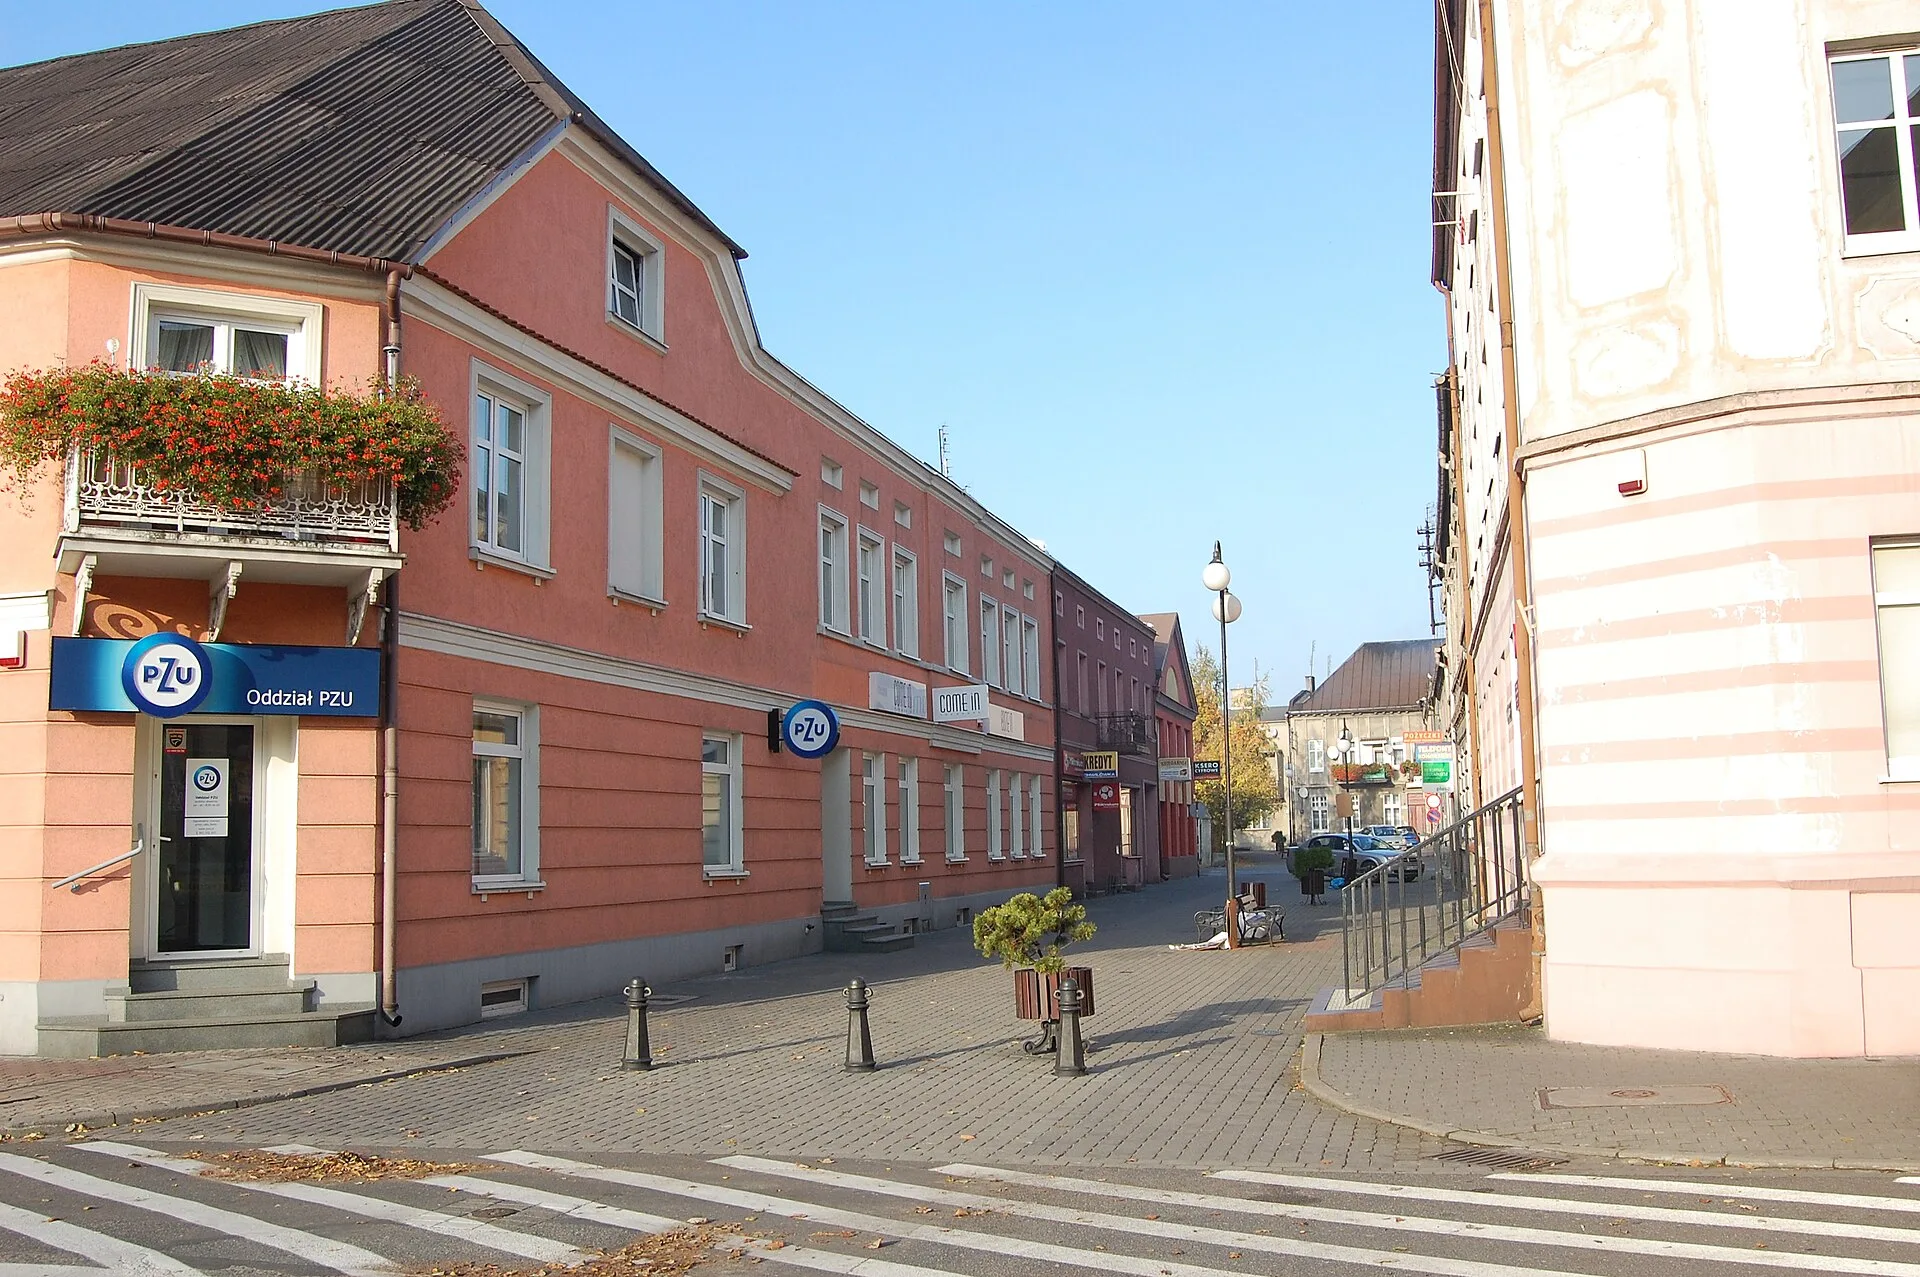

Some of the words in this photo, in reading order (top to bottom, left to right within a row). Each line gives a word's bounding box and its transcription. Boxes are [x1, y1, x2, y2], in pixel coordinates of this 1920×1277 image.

[143, 657, 196, 693] PZU
[246, 688, 313, 707] Oddział
[319, 690, 354, 707] PZU
[939, 692, 968, 713] COME
[794, 717, 826, 742] PZU
[1084, 755, 1113, 770] KREDYT
[199, 773, 215, 784] PZU
